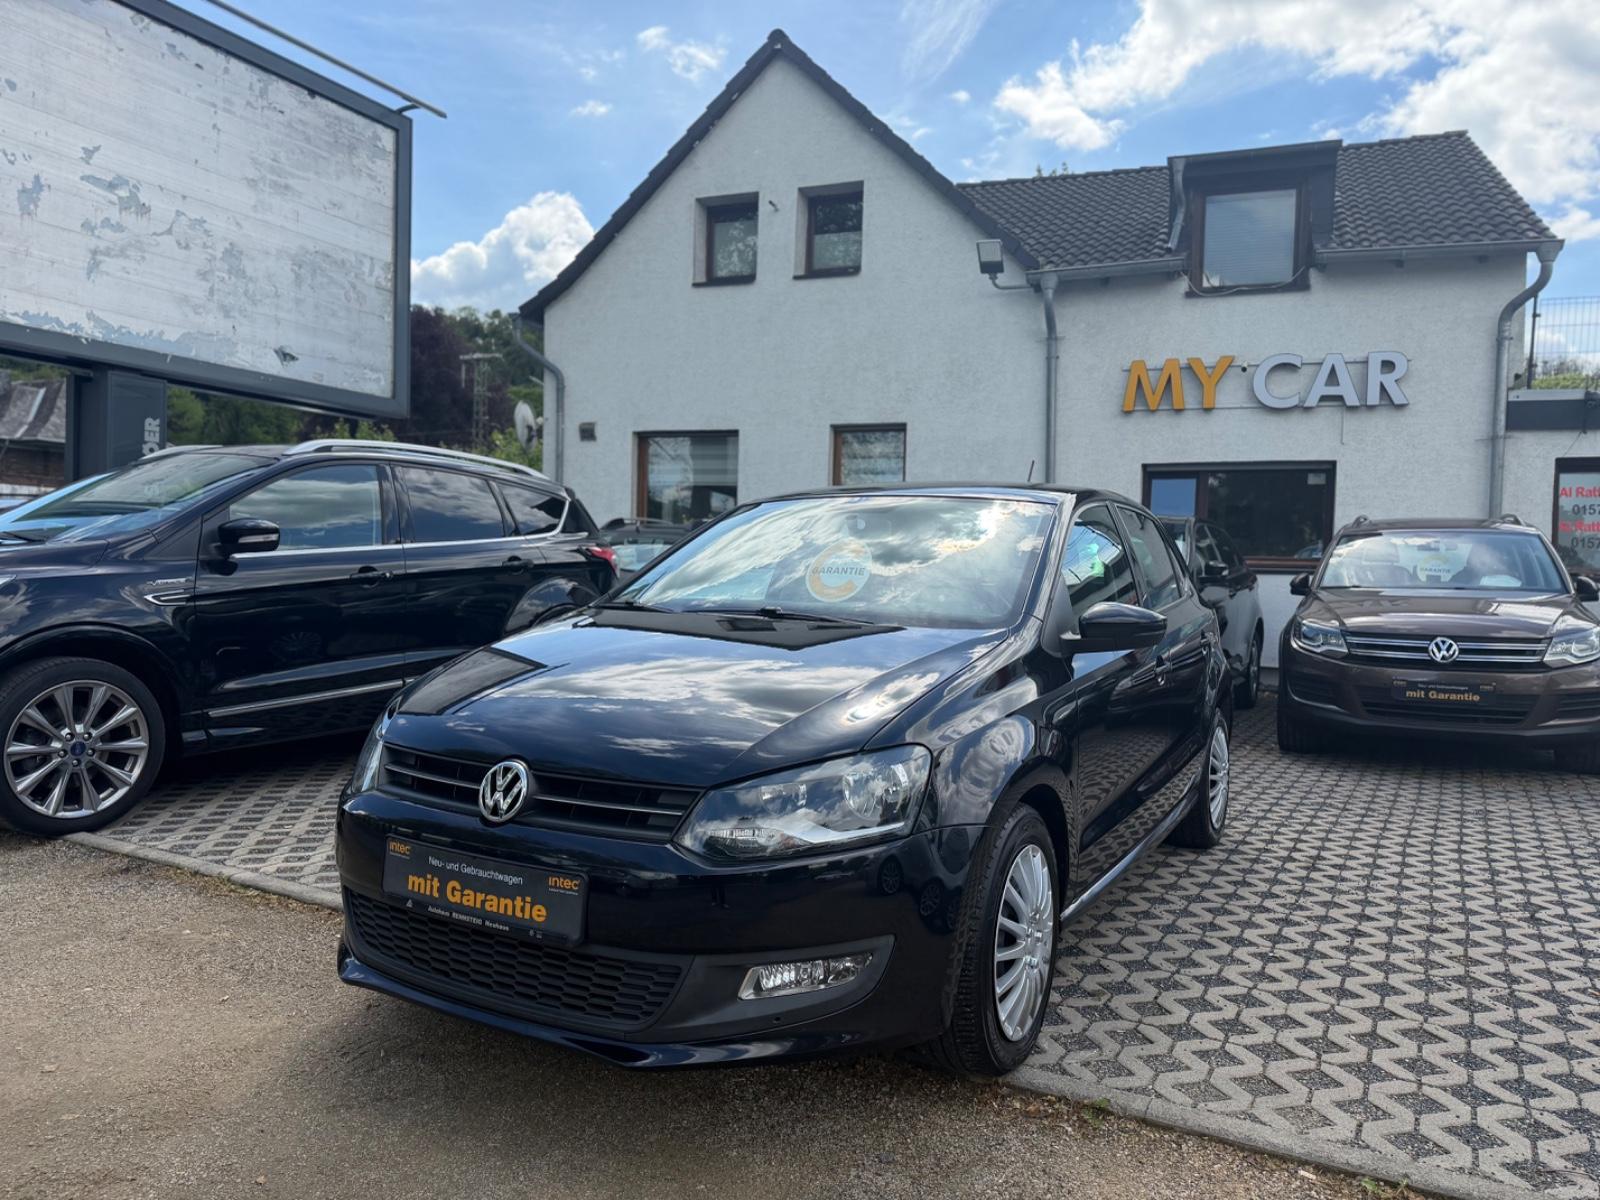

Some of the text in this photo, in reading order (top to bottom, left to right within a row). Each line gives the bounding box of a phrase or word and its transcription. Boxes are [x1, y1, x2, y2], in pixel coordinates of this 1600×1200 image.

[1122, 351, 1410, 412] MY CAR
[1406, 689, 1480, 701] mit Garantie
[390, 840, 412, 855] intec
[428, 856, 523, 885] Neu- und Gebrauchtwagen
[548, 876, 581, 891] intec
[407, 873, 548, 922] mit Garantie
